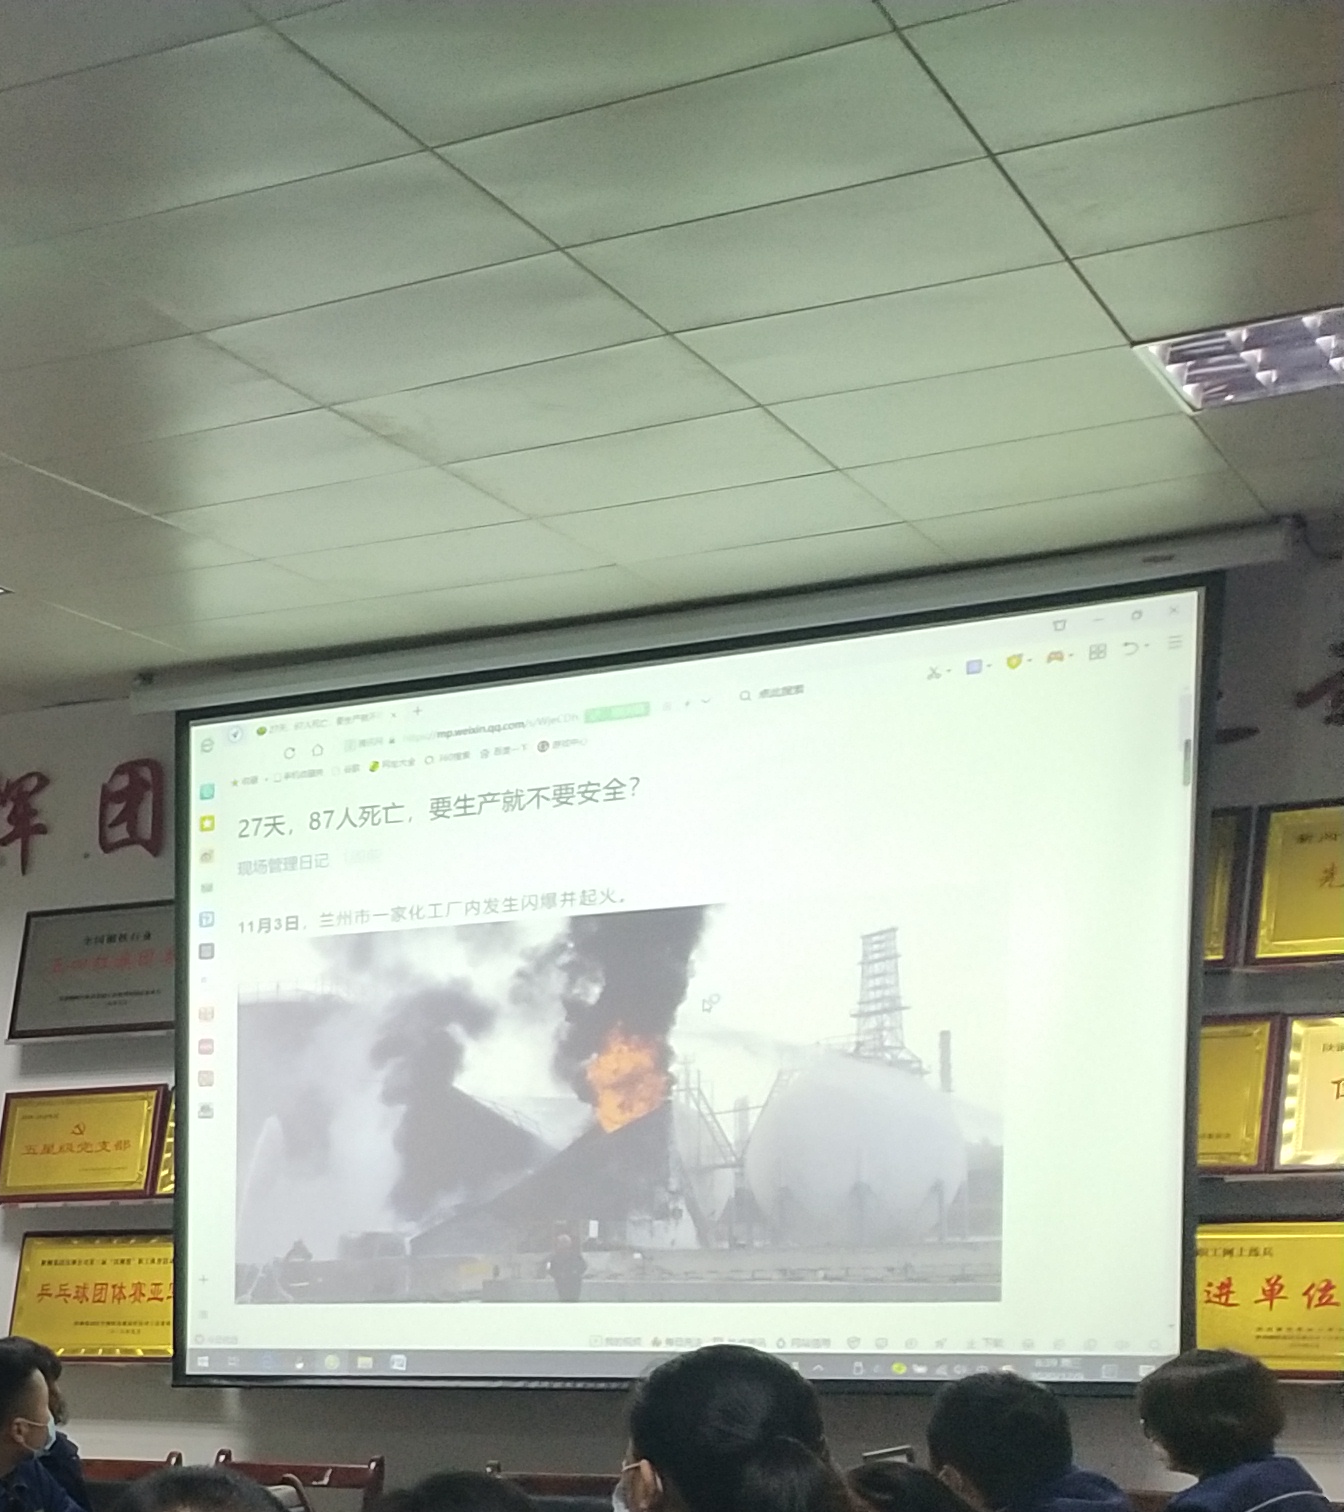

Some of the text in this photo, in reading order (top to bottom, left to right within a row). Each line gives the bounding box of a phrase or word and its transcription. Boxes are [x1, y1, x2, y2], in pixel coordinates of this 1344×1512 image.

[237, 852, 330, 877] 现场管理日记
[21, 1138, 131, 1156] 五星级党支部
[1203, 1274, 1341, 1312] 进单位
